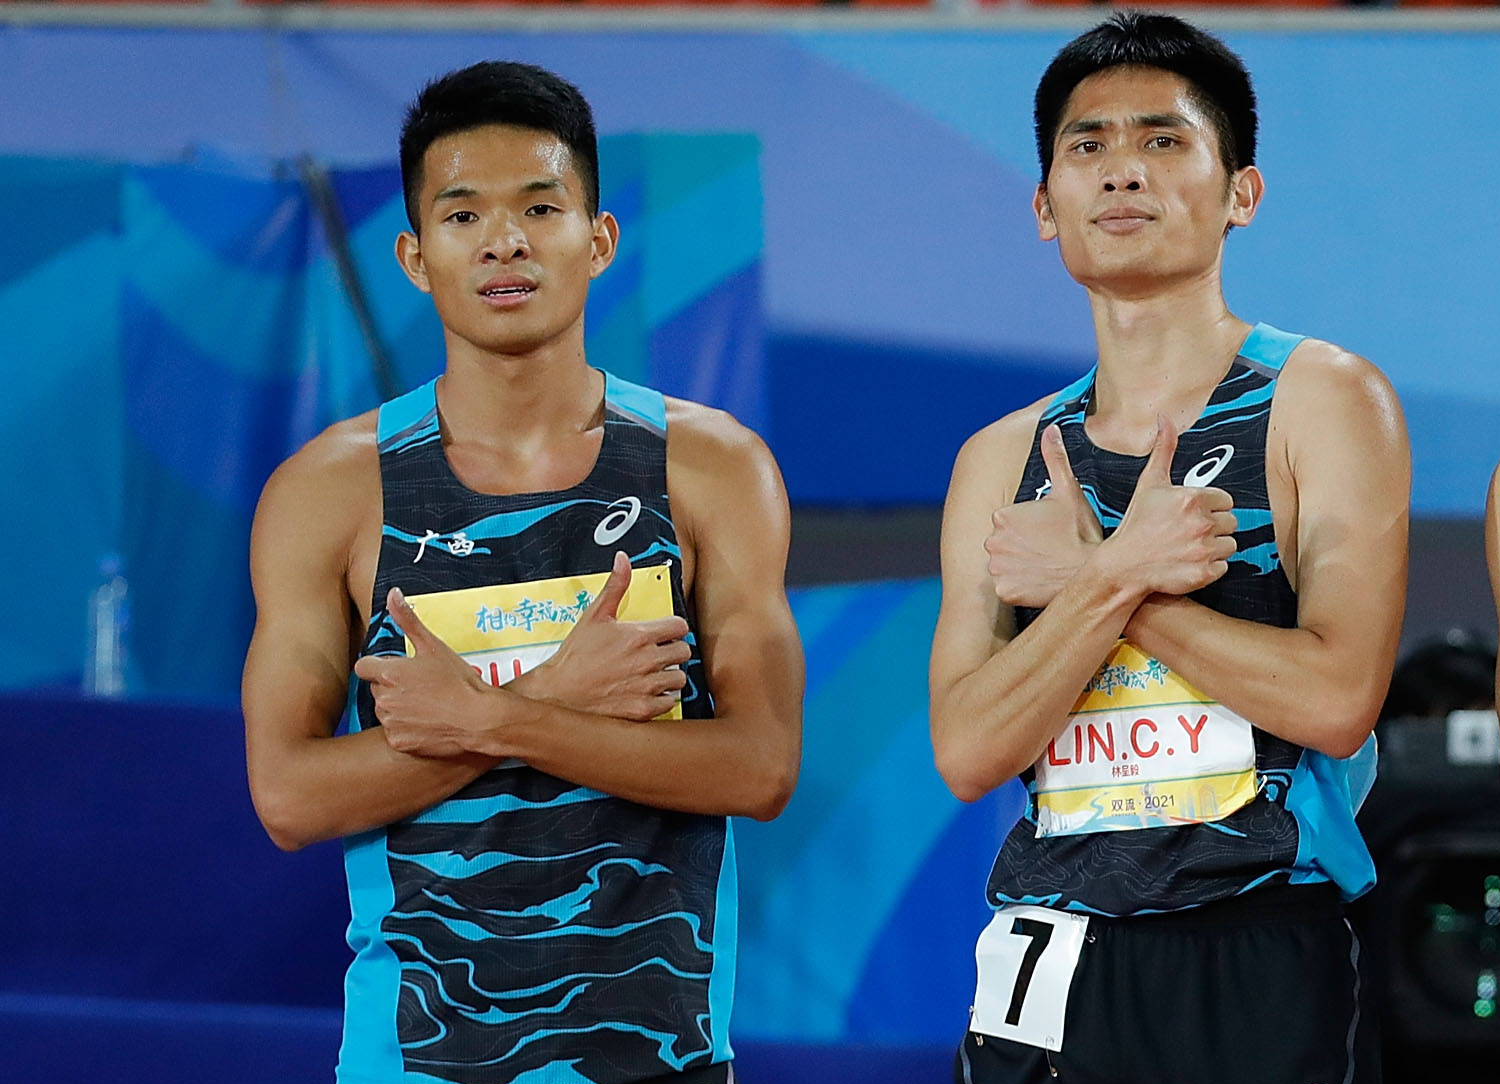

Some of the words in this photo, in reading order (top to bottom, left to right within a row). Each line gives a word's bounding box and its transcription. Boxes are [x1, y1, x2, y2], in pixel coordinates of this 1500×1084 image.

[413, 529, 475, 563] 广西
[1047, 714, 1208, 767] LIN.C.Y
[1003, 917, 1056, 1027] 7
